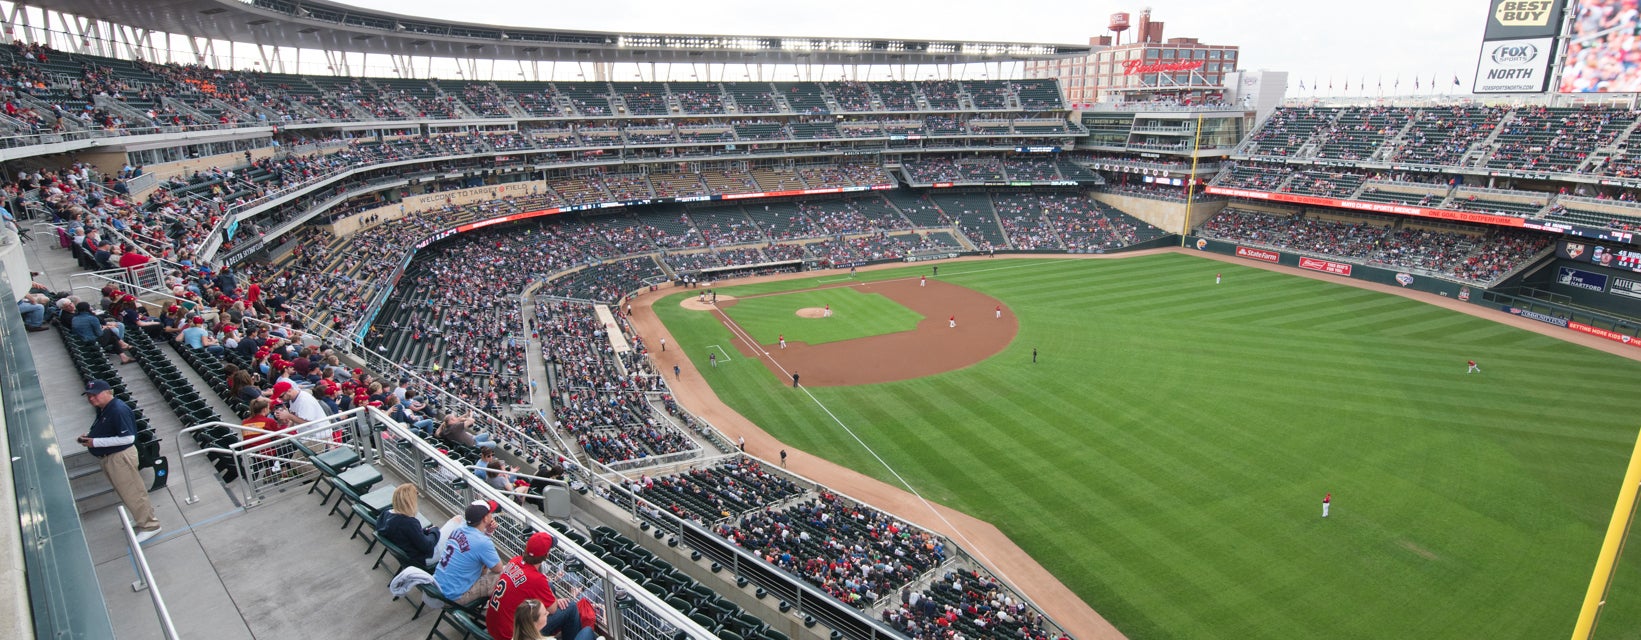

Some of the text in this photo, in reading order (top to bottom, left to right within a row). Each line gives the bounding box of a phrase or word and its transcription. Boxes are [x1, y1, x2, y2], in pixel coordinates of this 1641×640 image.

[1503, 1, 1552, 11] BEST
[1503, 11, 1544, 21] BUY
[1500, 46, 1528, 57] FOX
[1121, 58, 1204, 77] Budweiser
[1487, 68, 1533, 80] NORTH
[420, 193, 456, 204] WELCOME
[470, 187, 497, 196] TARGET
[1356, 202, 1372, 210] CLINIC
[1373, 204, 1394, 212] SPORTS
[1394, 206, 1420, 215] MEDICINE
[229, 253, 244, 265] DELTA
[1570, 281, 1602, 291] HARTFORD
[1521, 310, 1551, 322] COMMUNITY
[1551, 317, 1567, 327] FUND
[1592, 328, 1608, 337] MORE
[1608, 332, 1621, 340] KIDS
[1630, 338, 1641, 346] THE
[440, 545, 455, 568] 3
[503, 561, 527, 588] OZIER
[490, 579, 507, 612] 2
